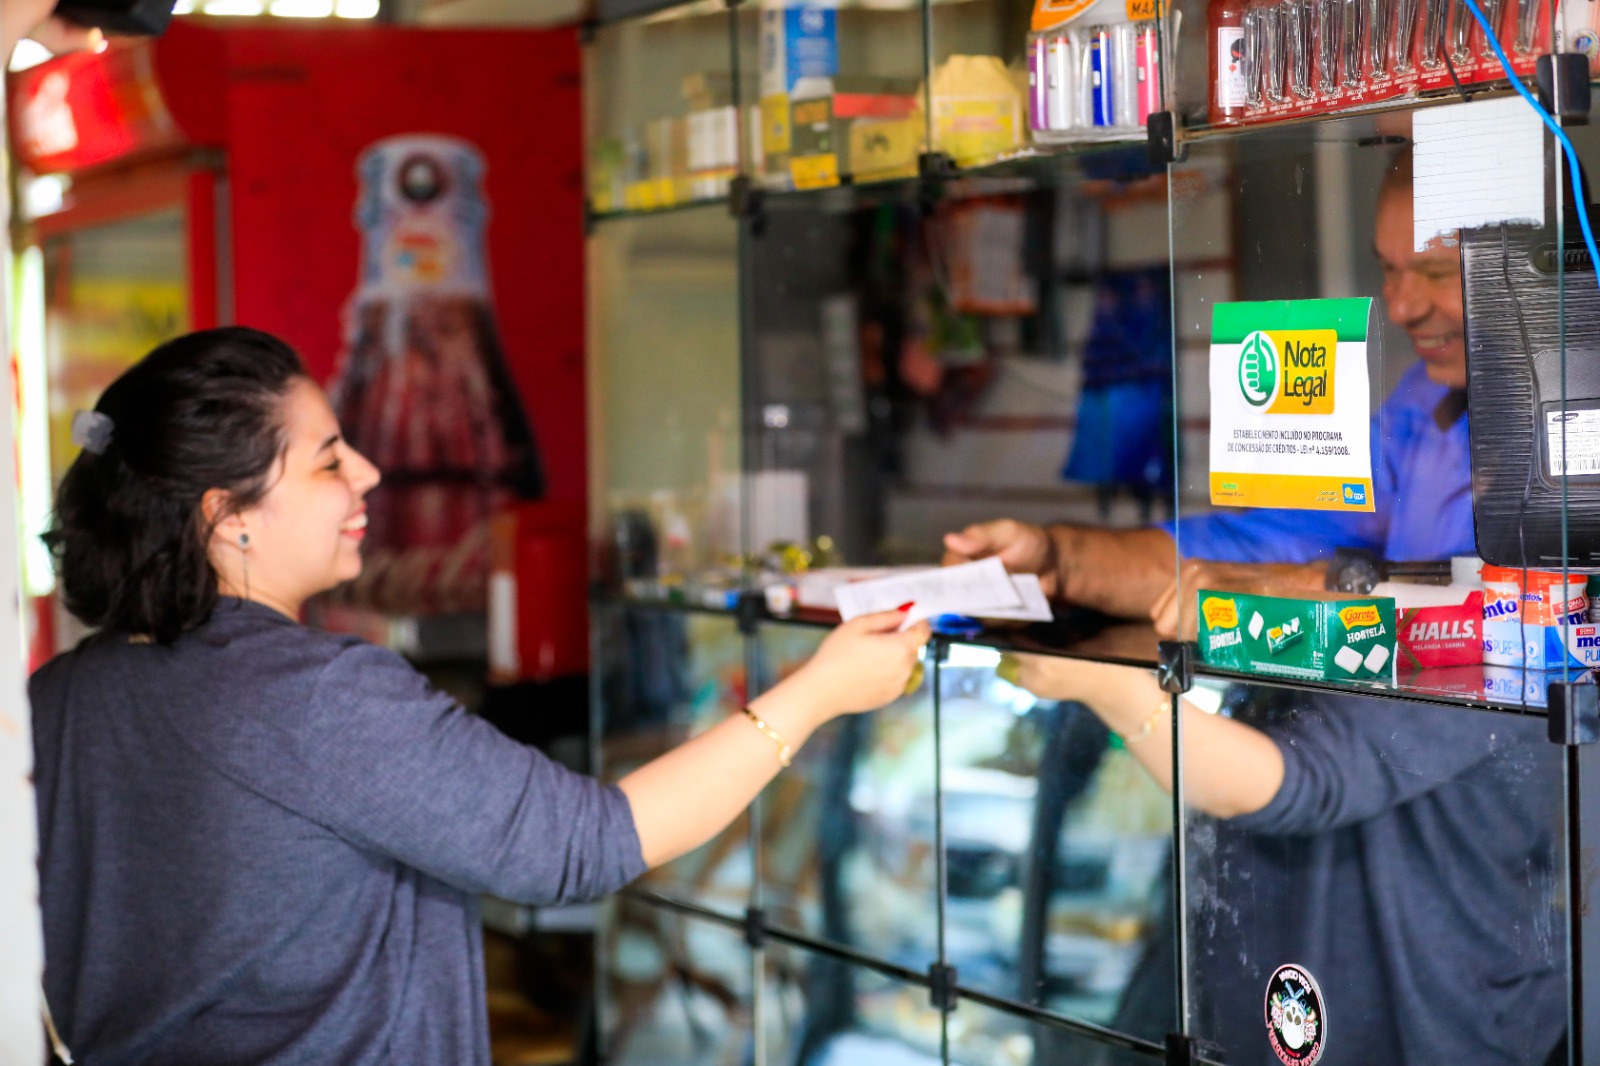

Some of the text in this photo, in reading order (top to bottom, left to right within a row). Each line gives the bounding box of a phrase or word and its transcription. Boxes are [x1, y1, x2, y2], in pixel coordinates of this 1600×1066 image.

[1284, 340, 1326, 368] Nota
[1284, 369, 1328, 406] Legal
[1233, 429, 1279, 440] ESTABELECIMENTO
[1303, 430, 1312, 441] NO
[1311, 430, 1343, 442] PROGRAMA
[1227, 442, 1234, 452] DE
[1234, 441, 1265, 453] CONCESSÃO
[1265, 443, 1272, 453] DE
[1272, 442, 1296, 454] CRÉDITOS
[1353, 492, 1365, 500] GDF
[1409, 619, 1475, 642] HALLS
